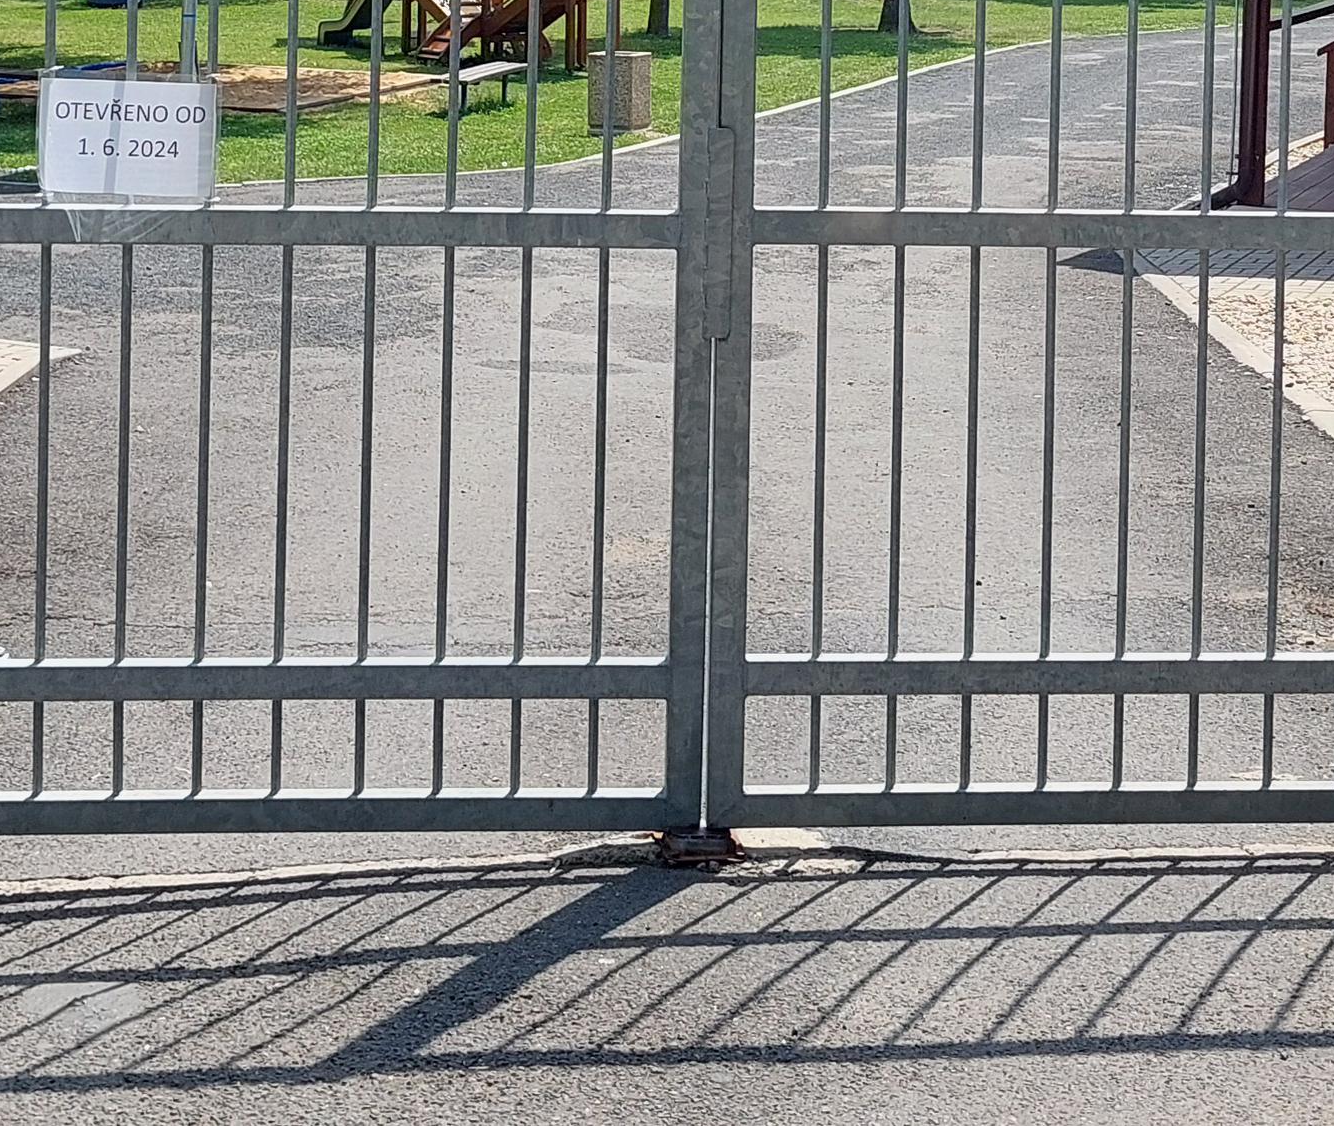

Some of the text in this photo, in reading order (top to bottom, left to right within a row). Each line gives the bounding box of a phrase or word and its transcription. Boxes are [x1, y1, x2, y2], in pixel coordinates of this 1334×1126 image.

[55, 98, 207, 124] OTEVŘENO OD
[78, 137, 180, 159] 1. 6. 2024
